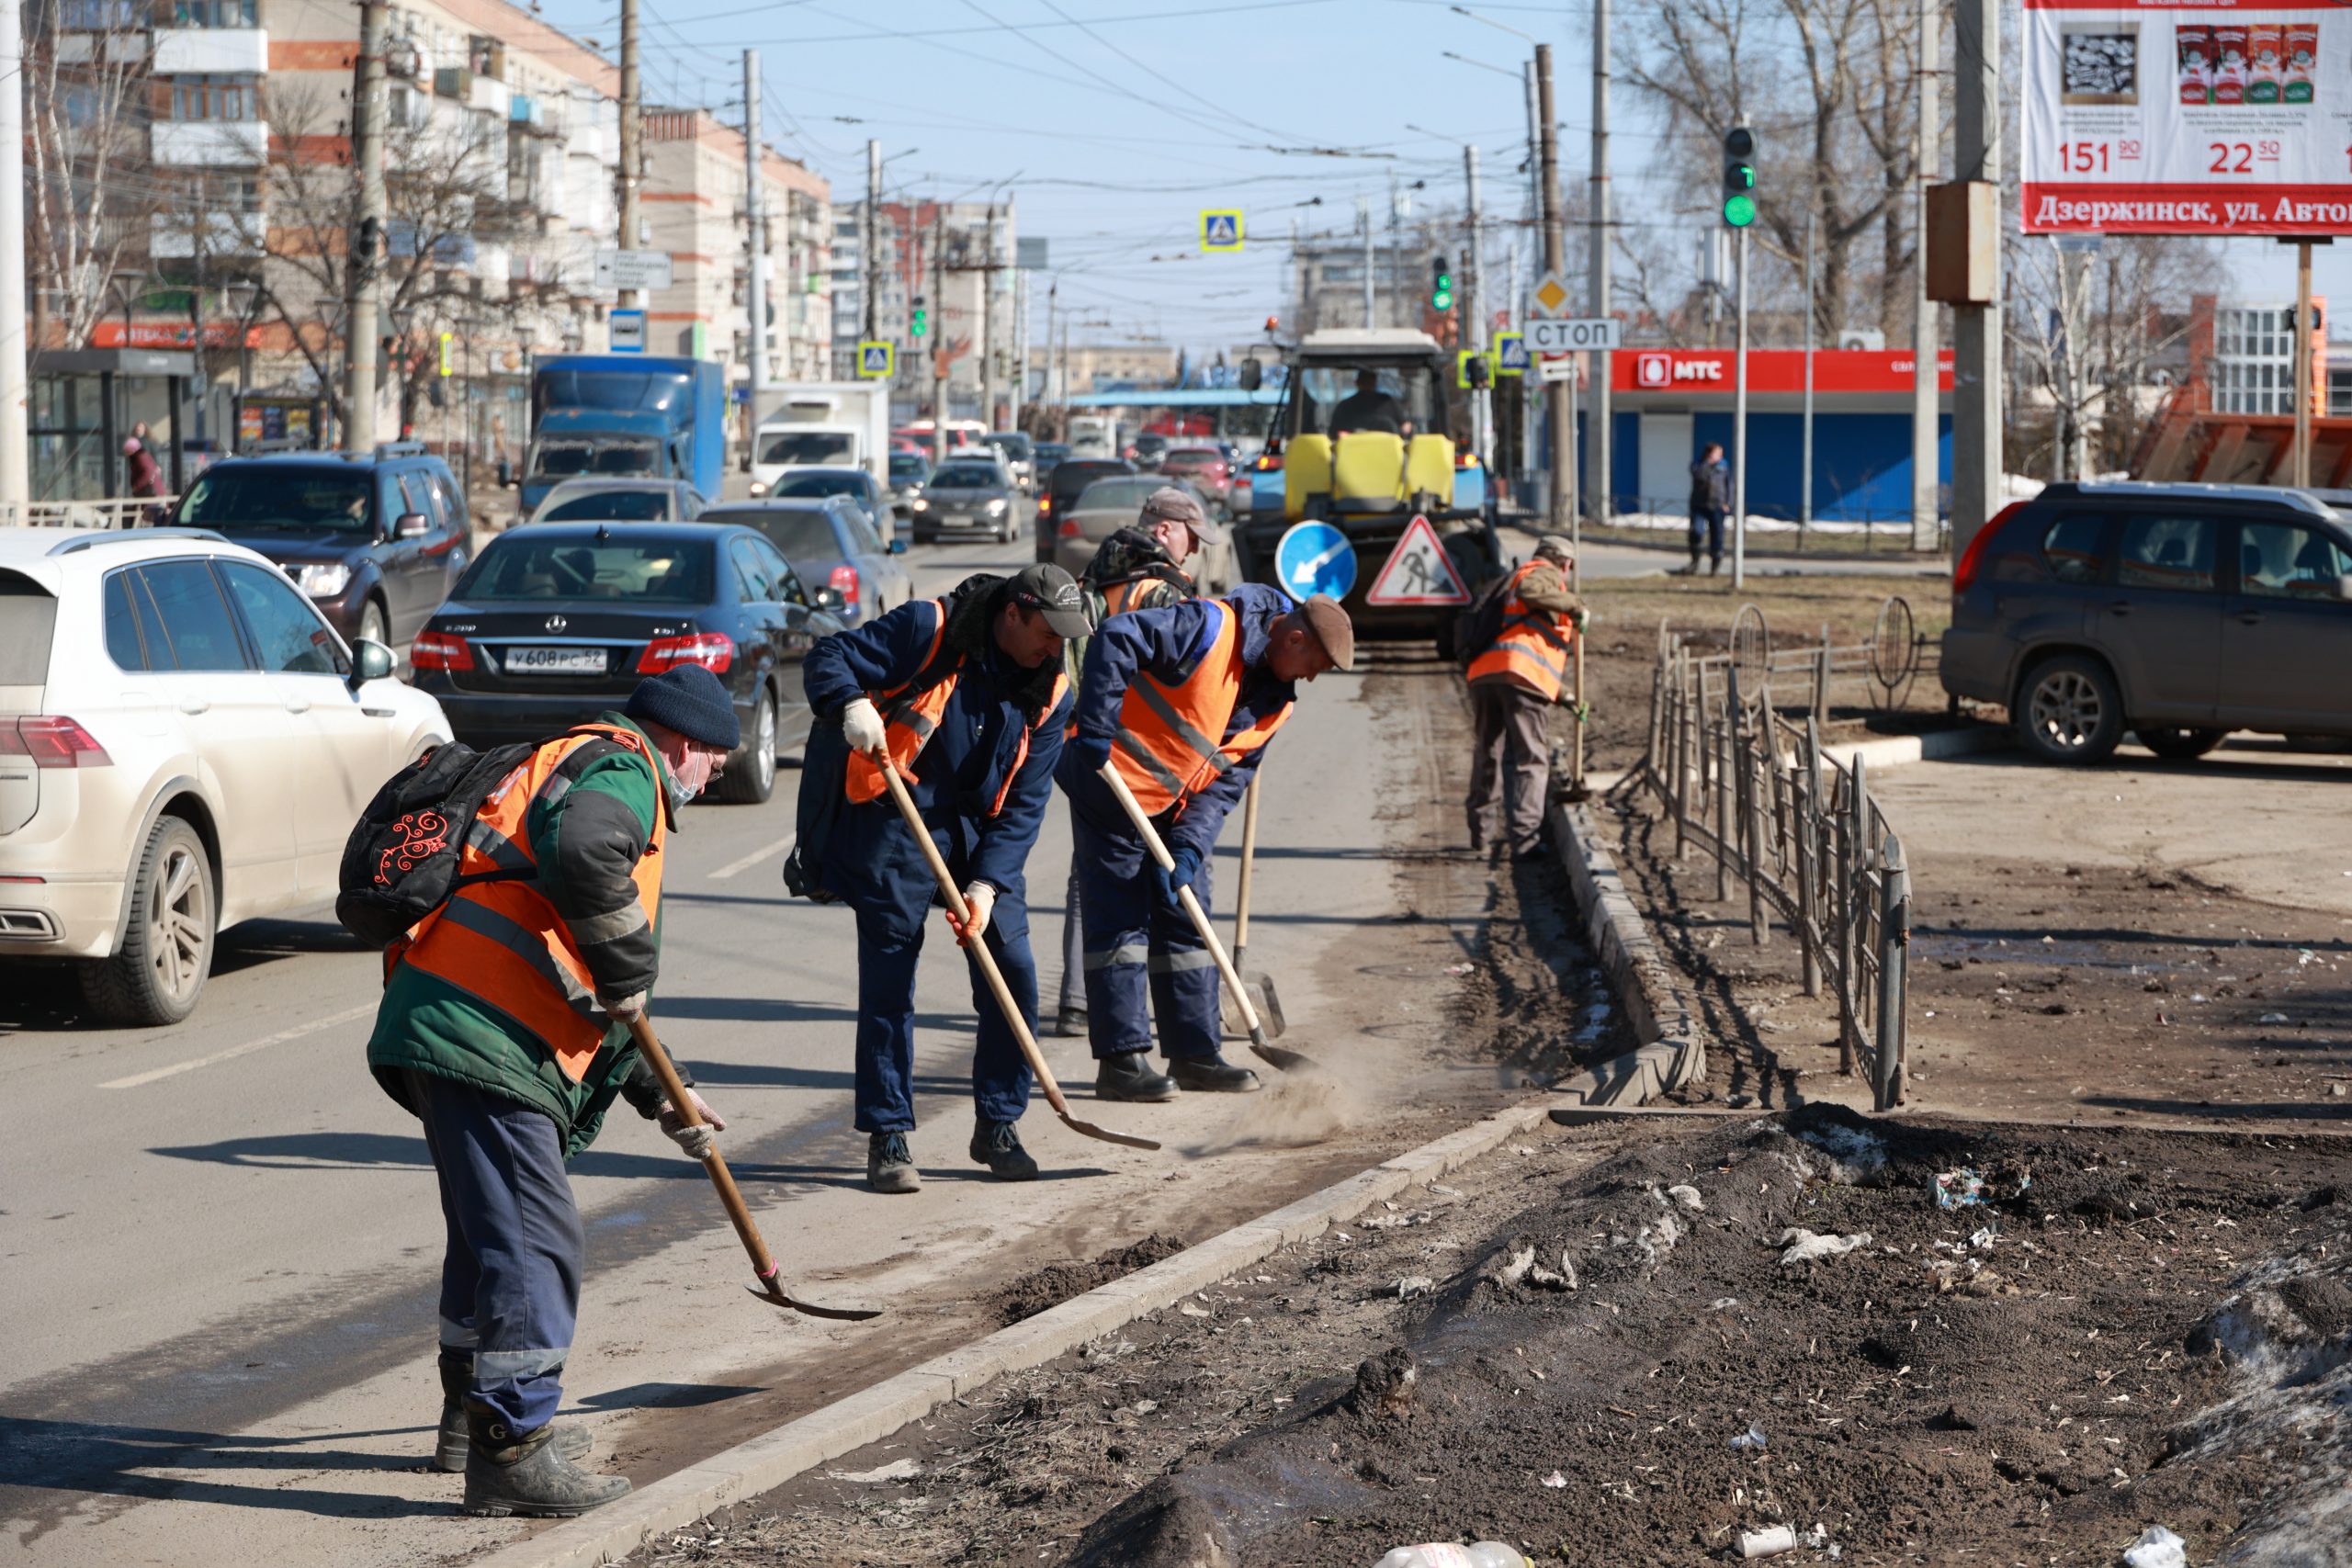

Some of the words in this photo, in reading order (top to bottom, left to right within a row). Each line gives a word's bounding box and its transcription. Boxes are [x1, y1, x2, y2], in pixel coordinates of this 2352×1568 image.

[2059, 142, 2109, 173] 151
[2209, 142, 2253, 174] 22
[2257, 141, 2280, 155] 50
[2034, 195, 2217, 227] Дзержинск,
[2223, 202, 2267, 228] ул.
[1535, 323, 1609, 345] СТОП
[1674, 360, 1723, 379] МТС
[489, 1424, 507, 1439] G
